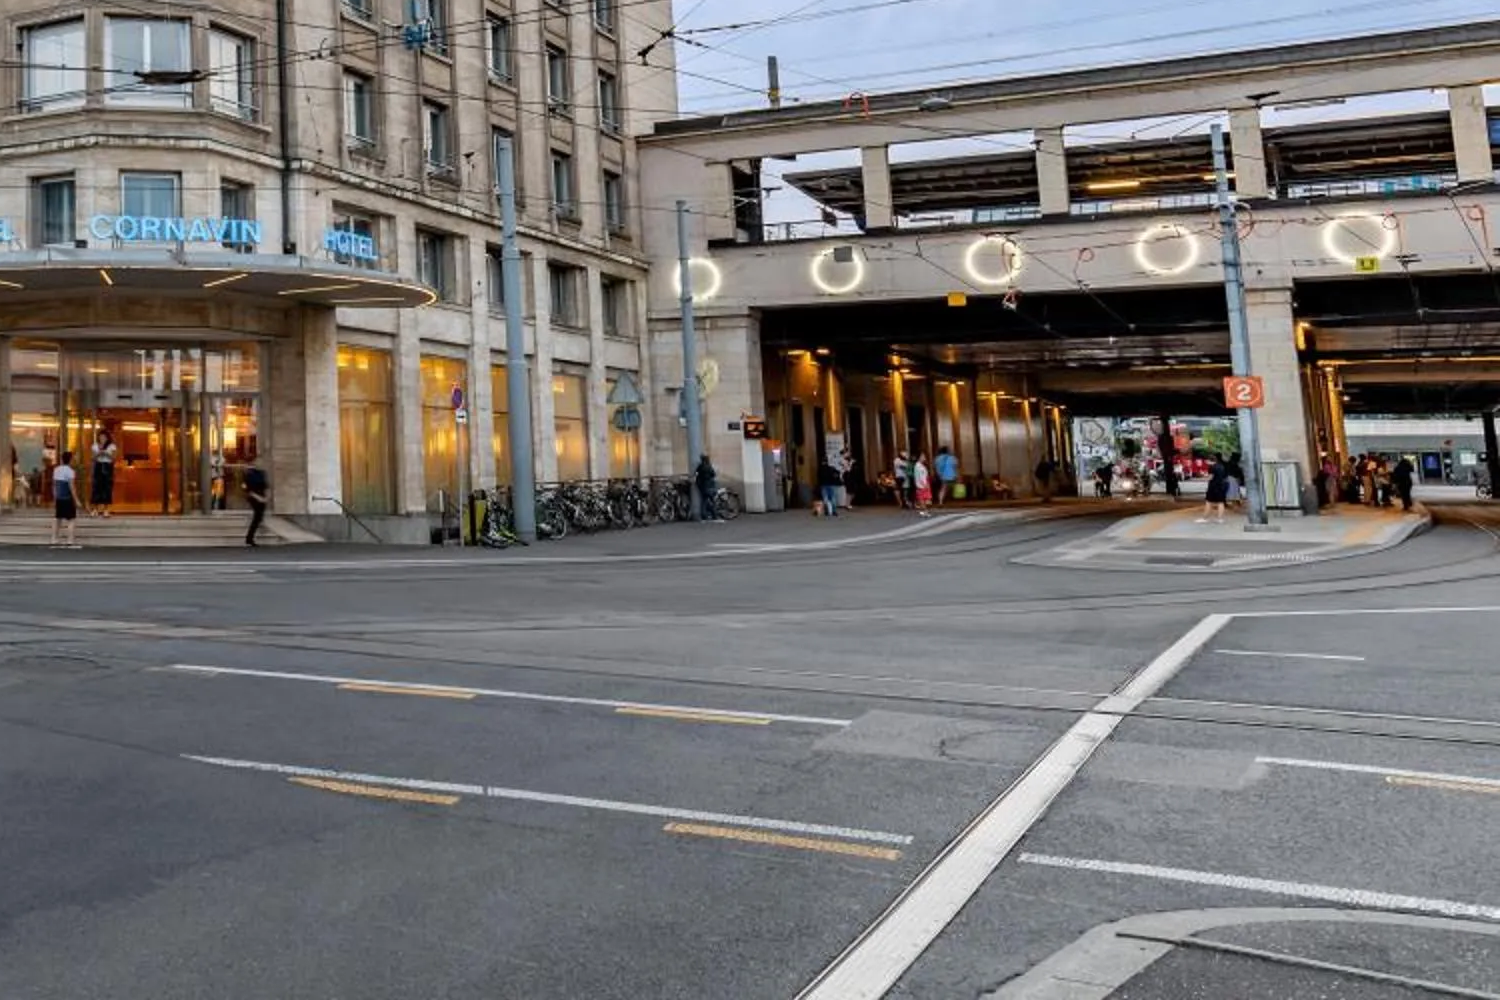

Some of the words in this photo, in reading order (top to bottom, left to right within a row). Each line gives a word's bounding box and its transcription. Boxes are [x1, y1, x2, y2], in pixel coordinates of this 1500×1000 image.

[90, 215, 262, 243] CORNAVIN
[324, 231, 378, 259] HOTEL
[1236, 383, 1252, 401] 2
